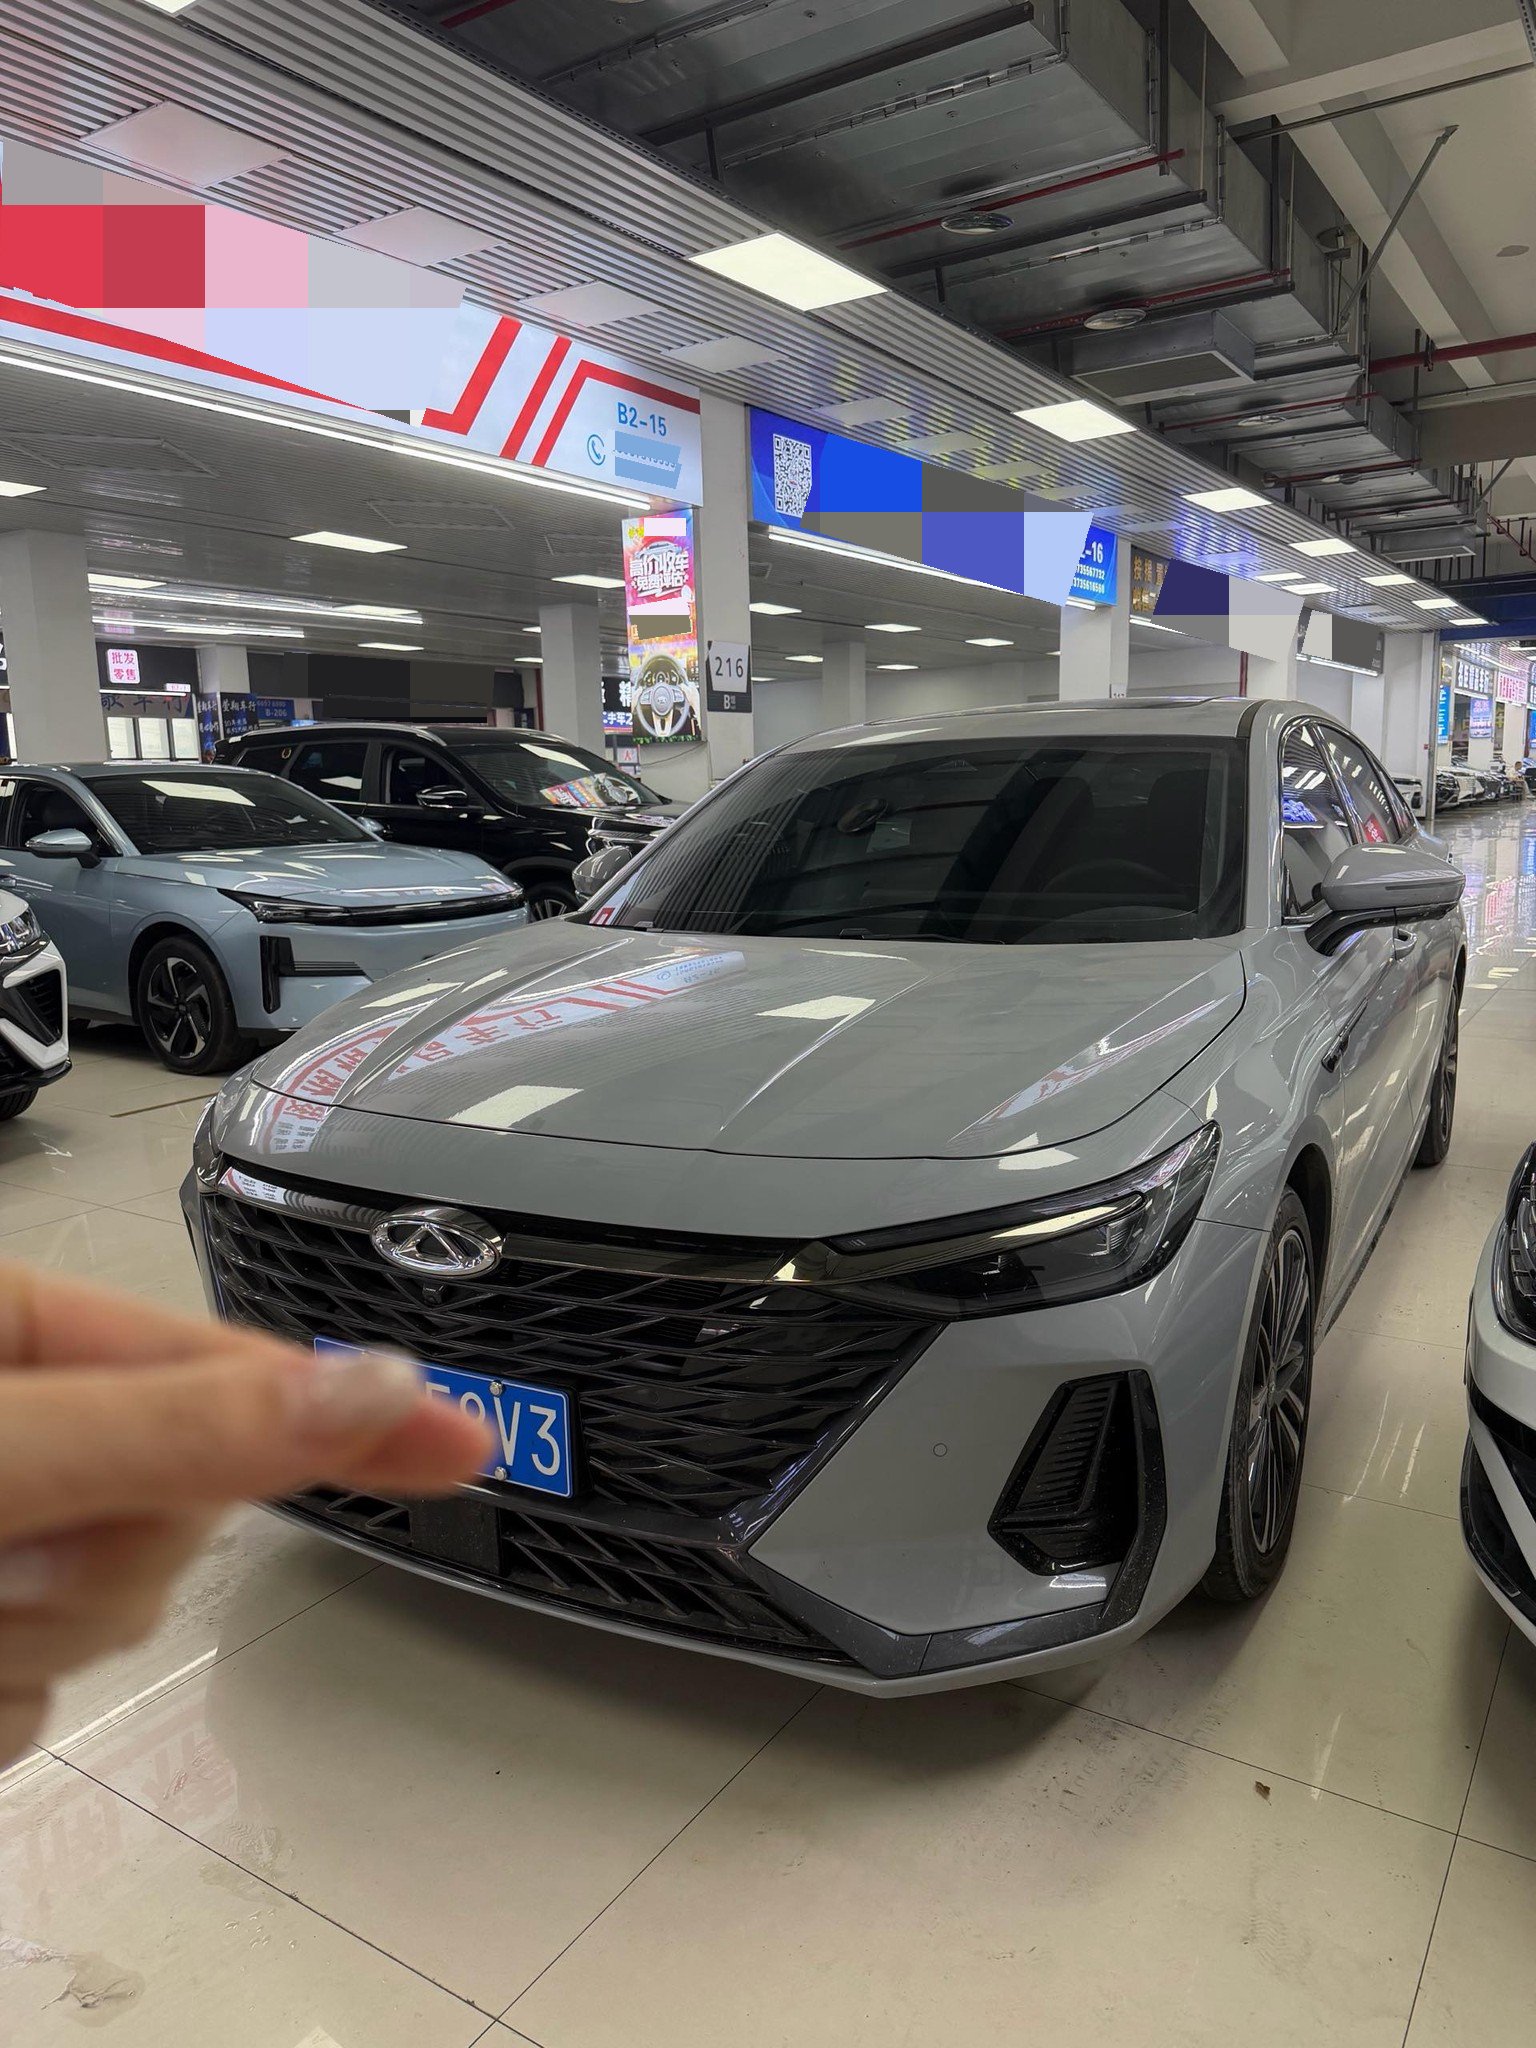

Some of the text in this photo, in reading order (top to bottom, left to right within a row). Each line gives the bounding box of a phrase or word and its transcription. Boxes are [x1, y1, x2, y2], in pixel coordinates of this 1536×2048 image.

[617, 402, 667, 437] B2-15
[1080, 541, 1104, 564] -16
[629, 551, 689, 577] 高价收车
[636, 573, 684, 591] 免费评估
[111, 652, 135, 665] 批发
[715, 656, 743, 678] 216
[113, 668, 137, 681] 零售
